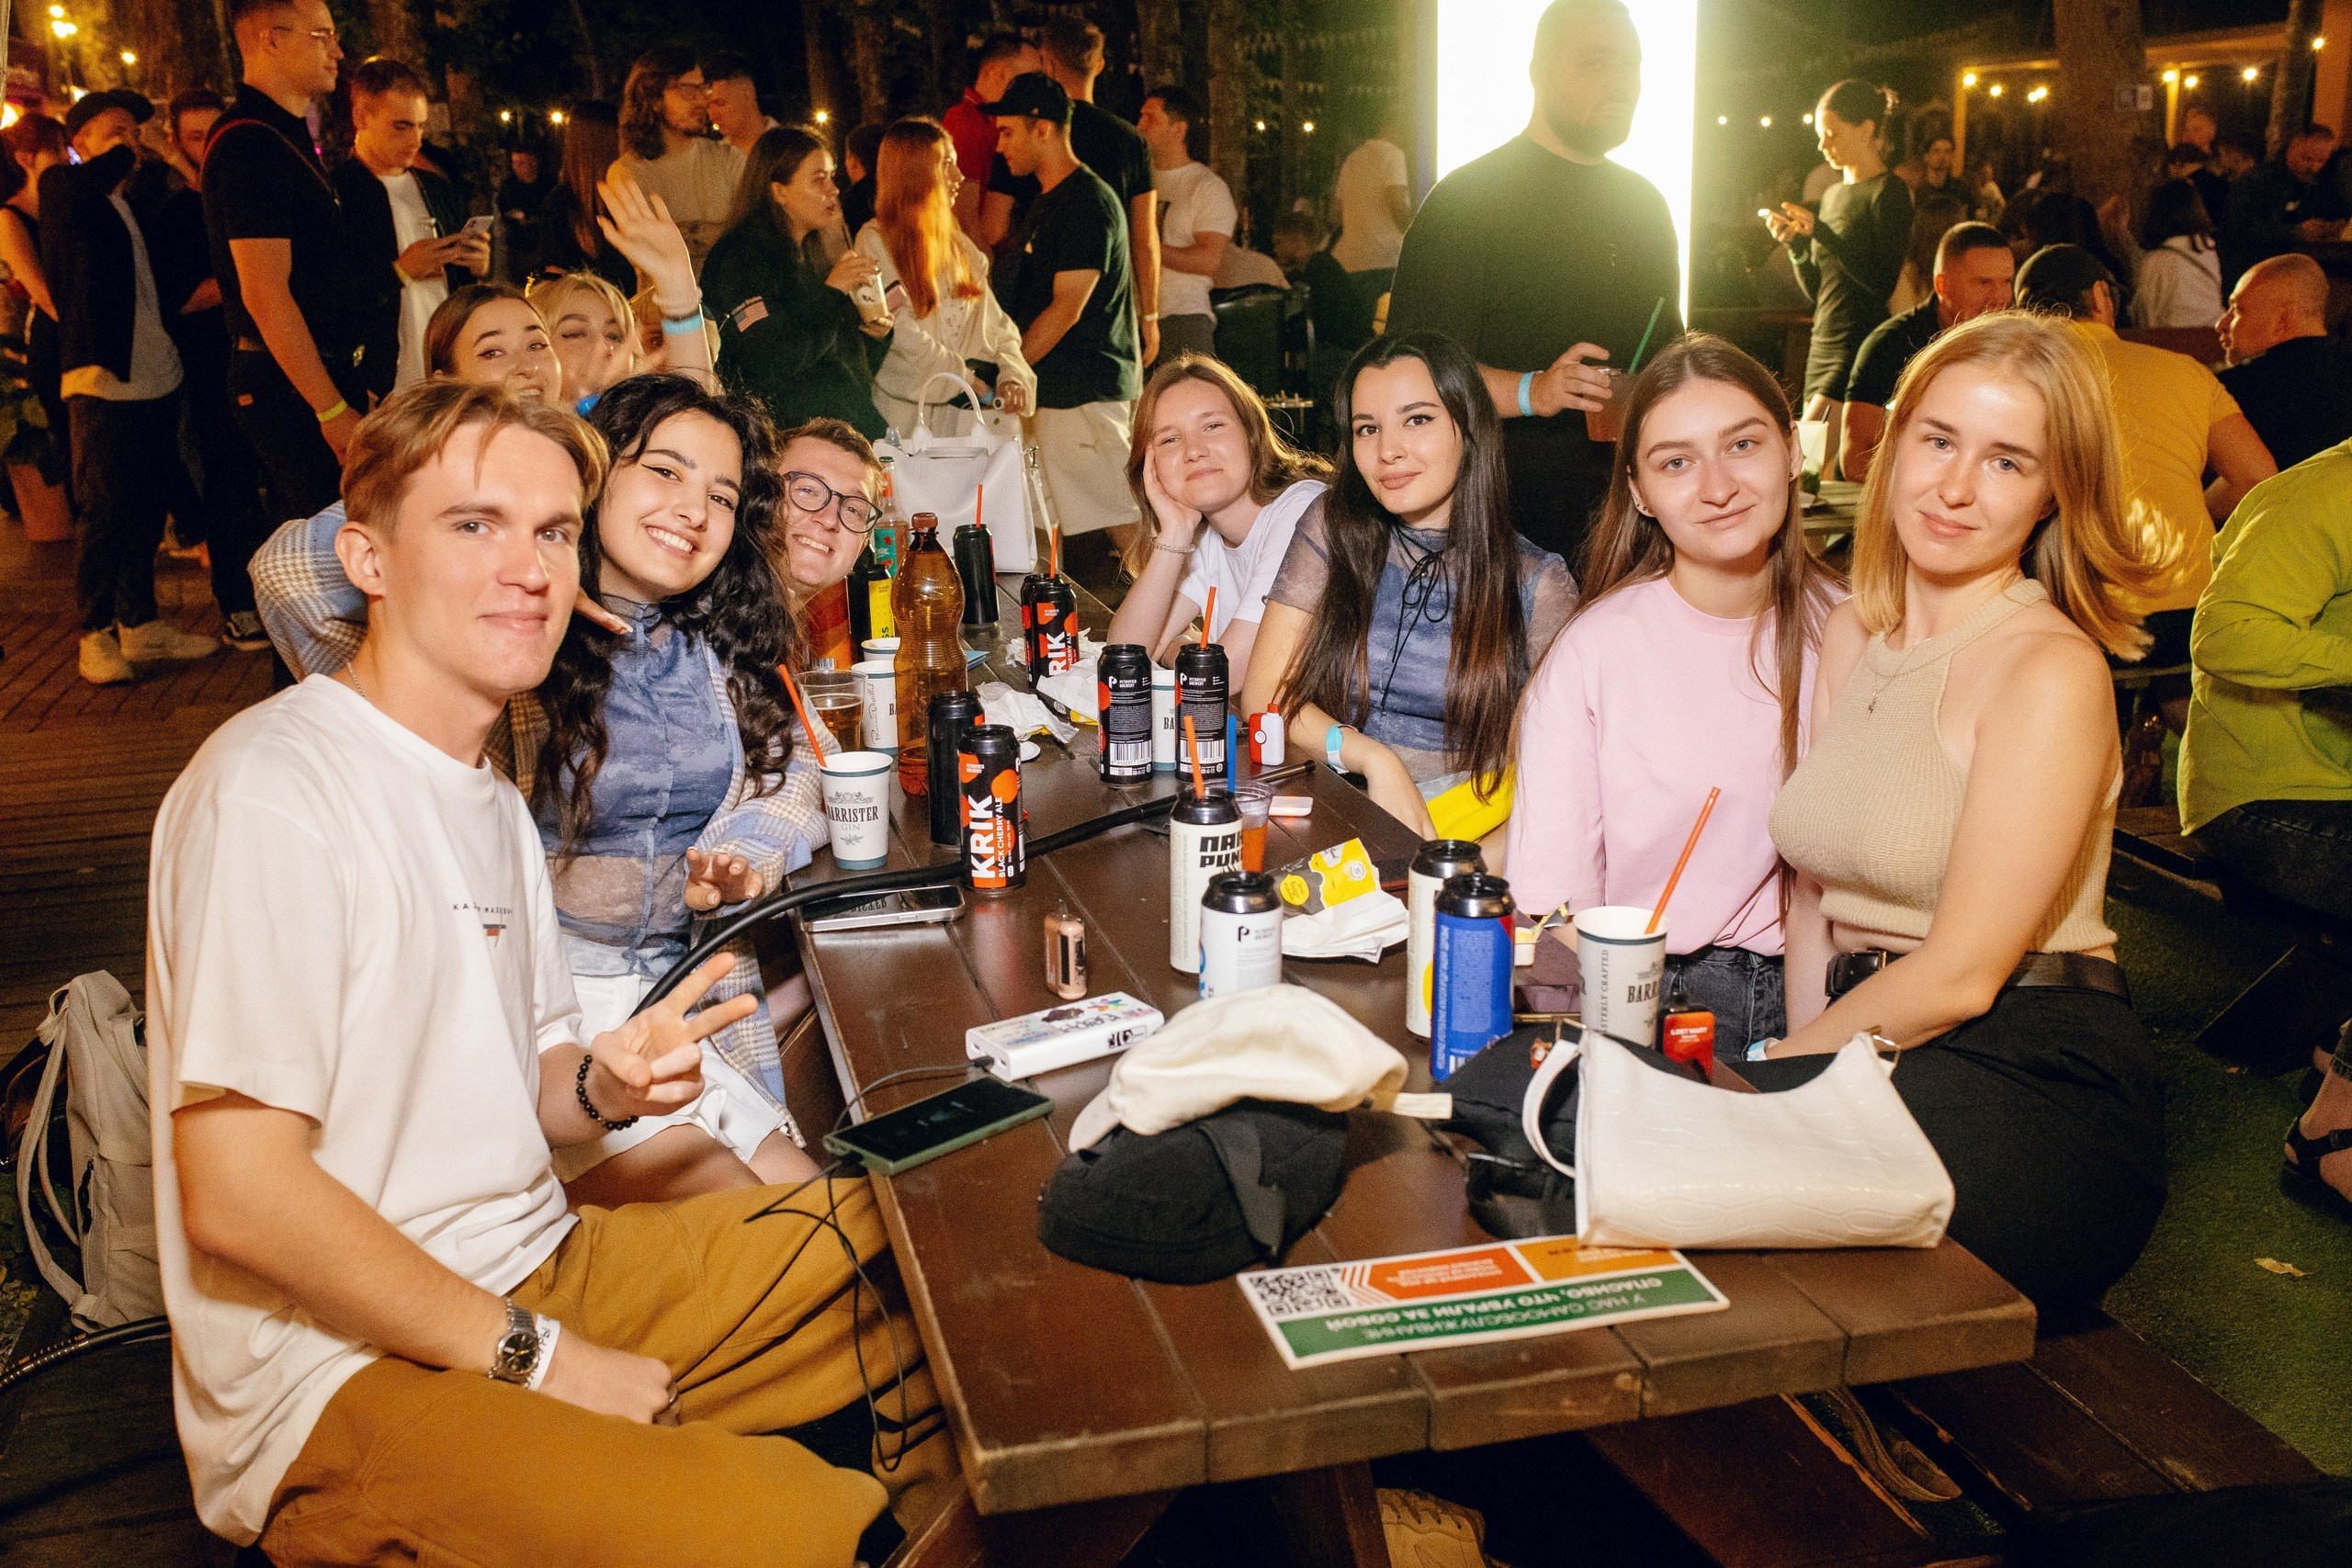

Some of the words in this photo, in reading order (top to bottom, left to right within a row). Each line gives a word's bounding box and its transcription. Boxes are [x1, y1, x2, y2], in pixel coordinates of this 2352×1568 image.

[1046, 631, 1066, 676] RIK
[995, 796, 1003, 813] ALE
[968, 795, 996, 879] KRIK
[995, 814, 1004, 849] CHERRY
[997, 850, 1006, 878] BLACK
[1600, 949, 1609, 992] CRAFTED
[1431, 1297, 1516, 1318] УБРАЛИ
[1517, 1292, 1562, 1307] ЧТО
[1586, 1295, 1630, 1311] НАС
[1634, 1293, 1645, 1304] У
[1326, 1312, 1401, 1333] СОБОЙ
[1401, 1308, 1430, 1321] ЗА
